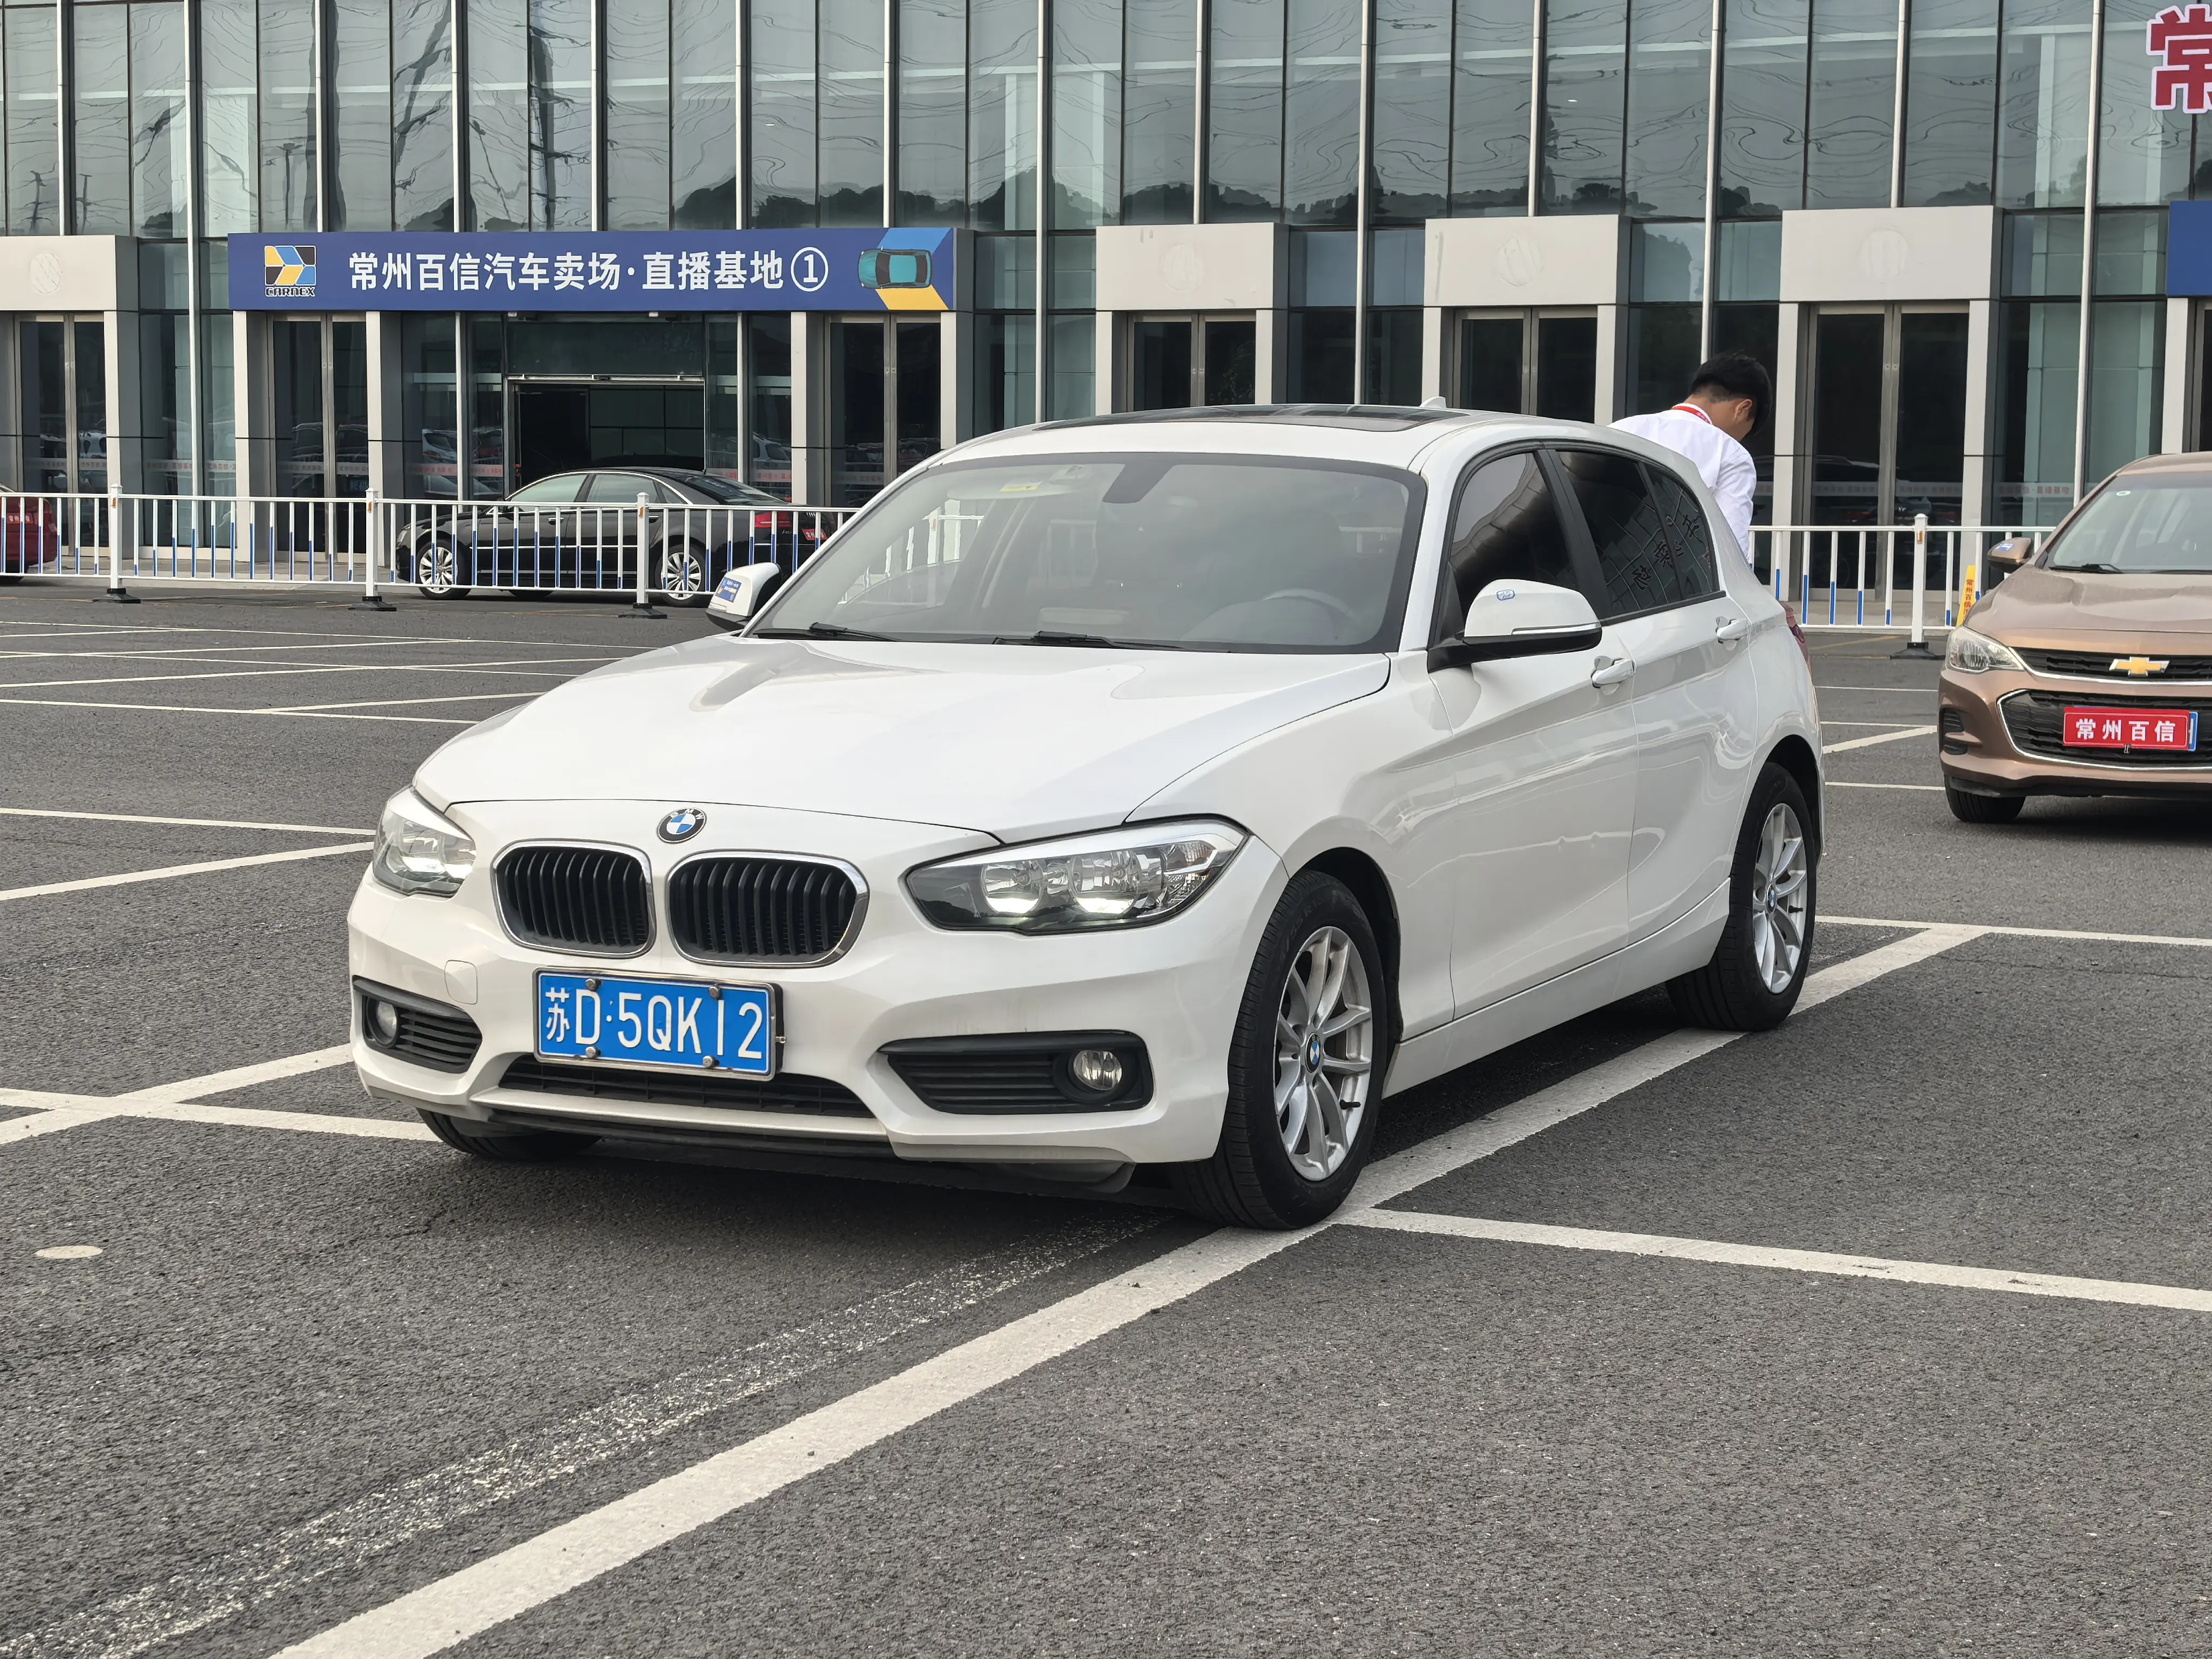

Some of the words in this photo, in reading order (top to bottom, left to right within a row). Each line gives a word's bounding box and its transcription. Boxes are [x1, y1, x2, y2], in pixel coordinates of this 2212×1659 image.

[2076, 718, 2176, 742] 常州百信
[670, 808, 704, 820] BMW
